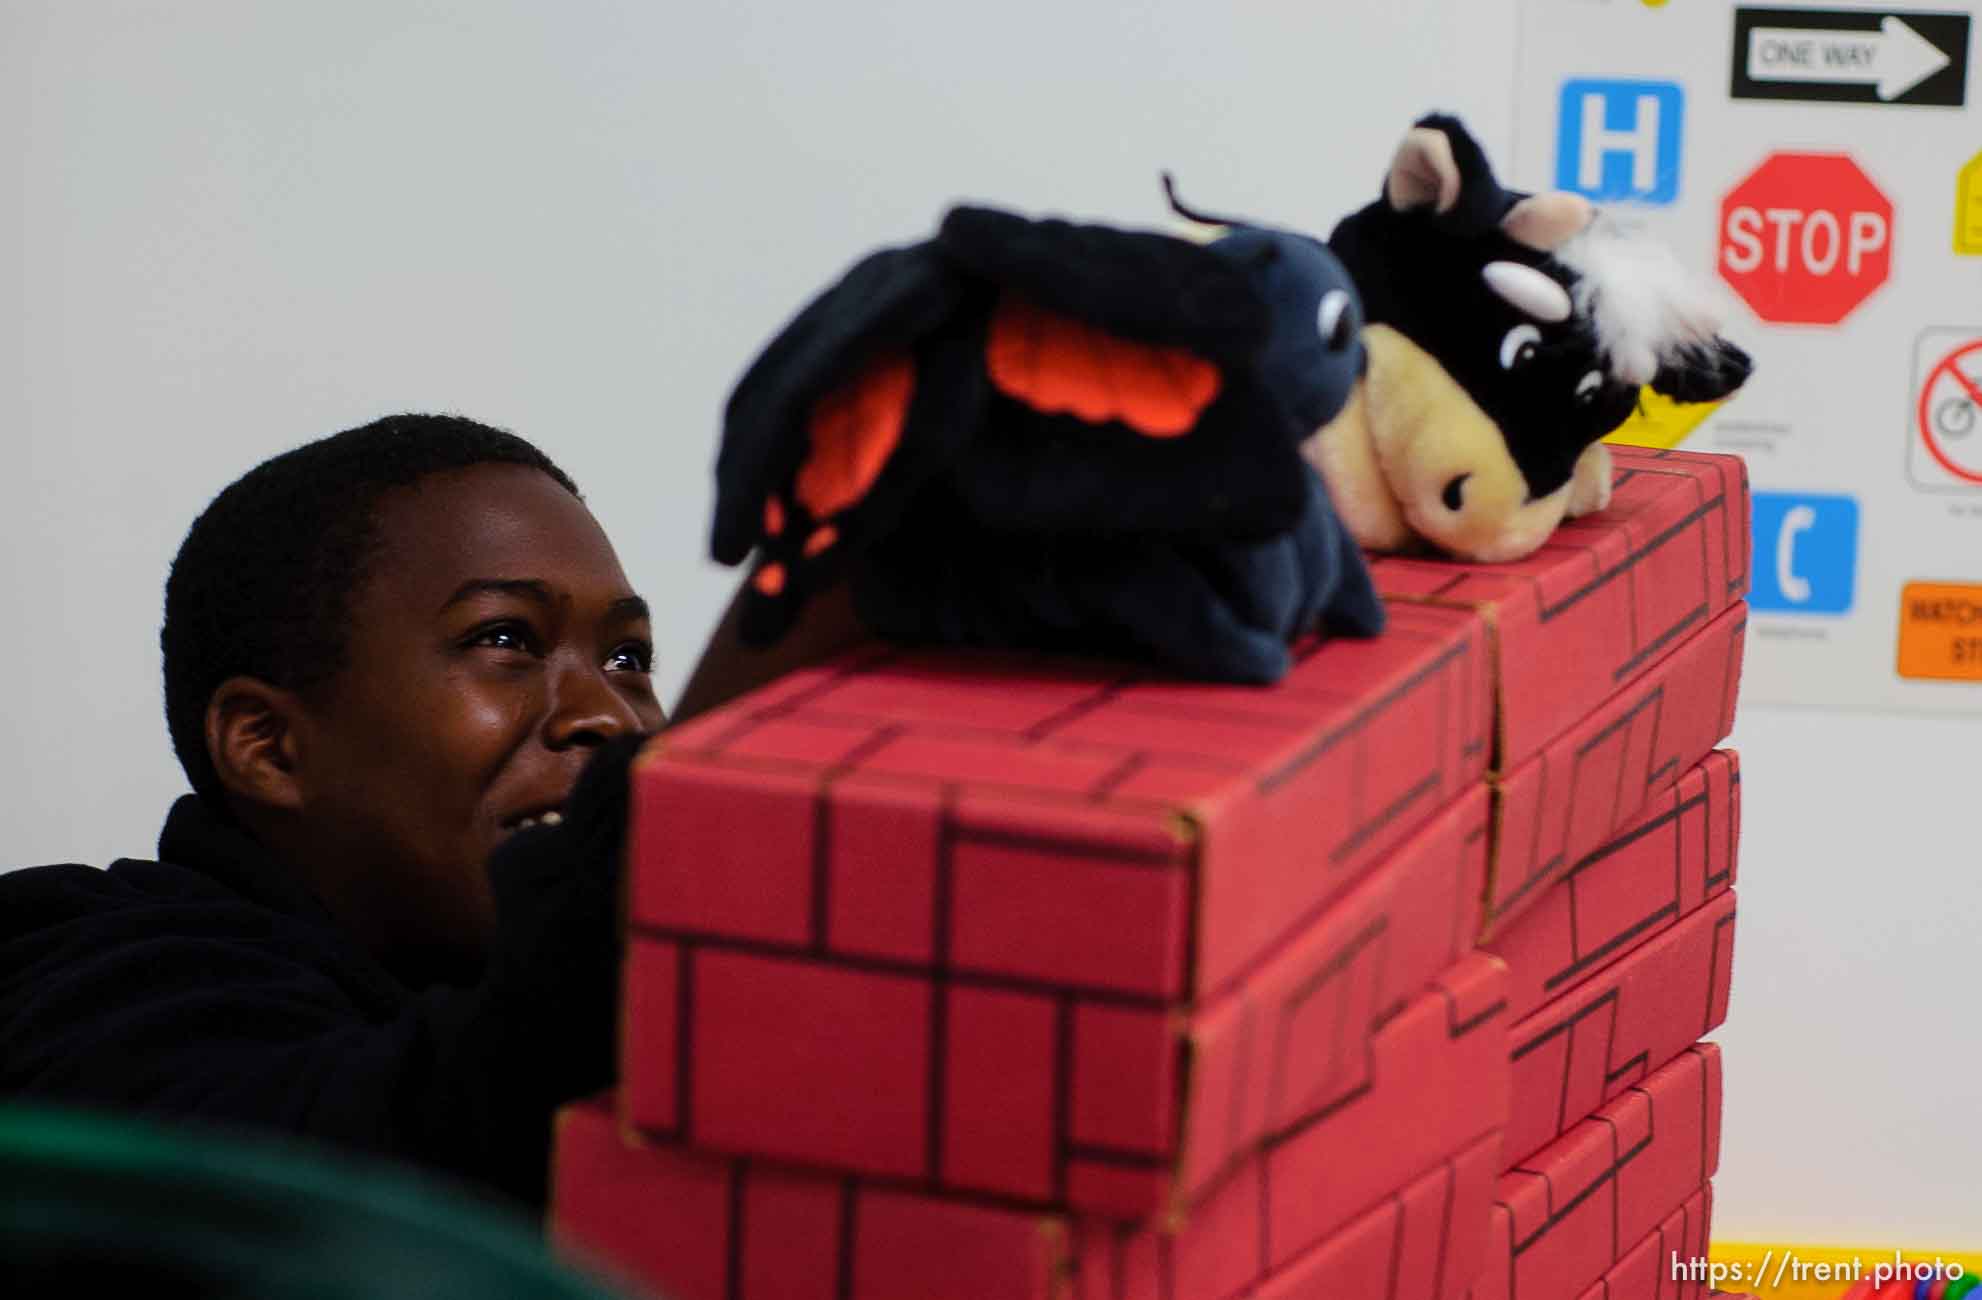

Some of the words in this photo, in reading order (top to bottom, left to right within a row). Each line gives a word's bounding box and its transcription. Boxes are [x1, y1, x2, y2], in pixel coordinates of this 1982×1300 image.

[1760, 40, 1811, 64] ONE
[1824, 42, 1876, 65] WAY
[1579, 93, 1660, 190] H
[1724, 205, 1886, 276] STOP
[1951, 636, 1982, 665] ST
